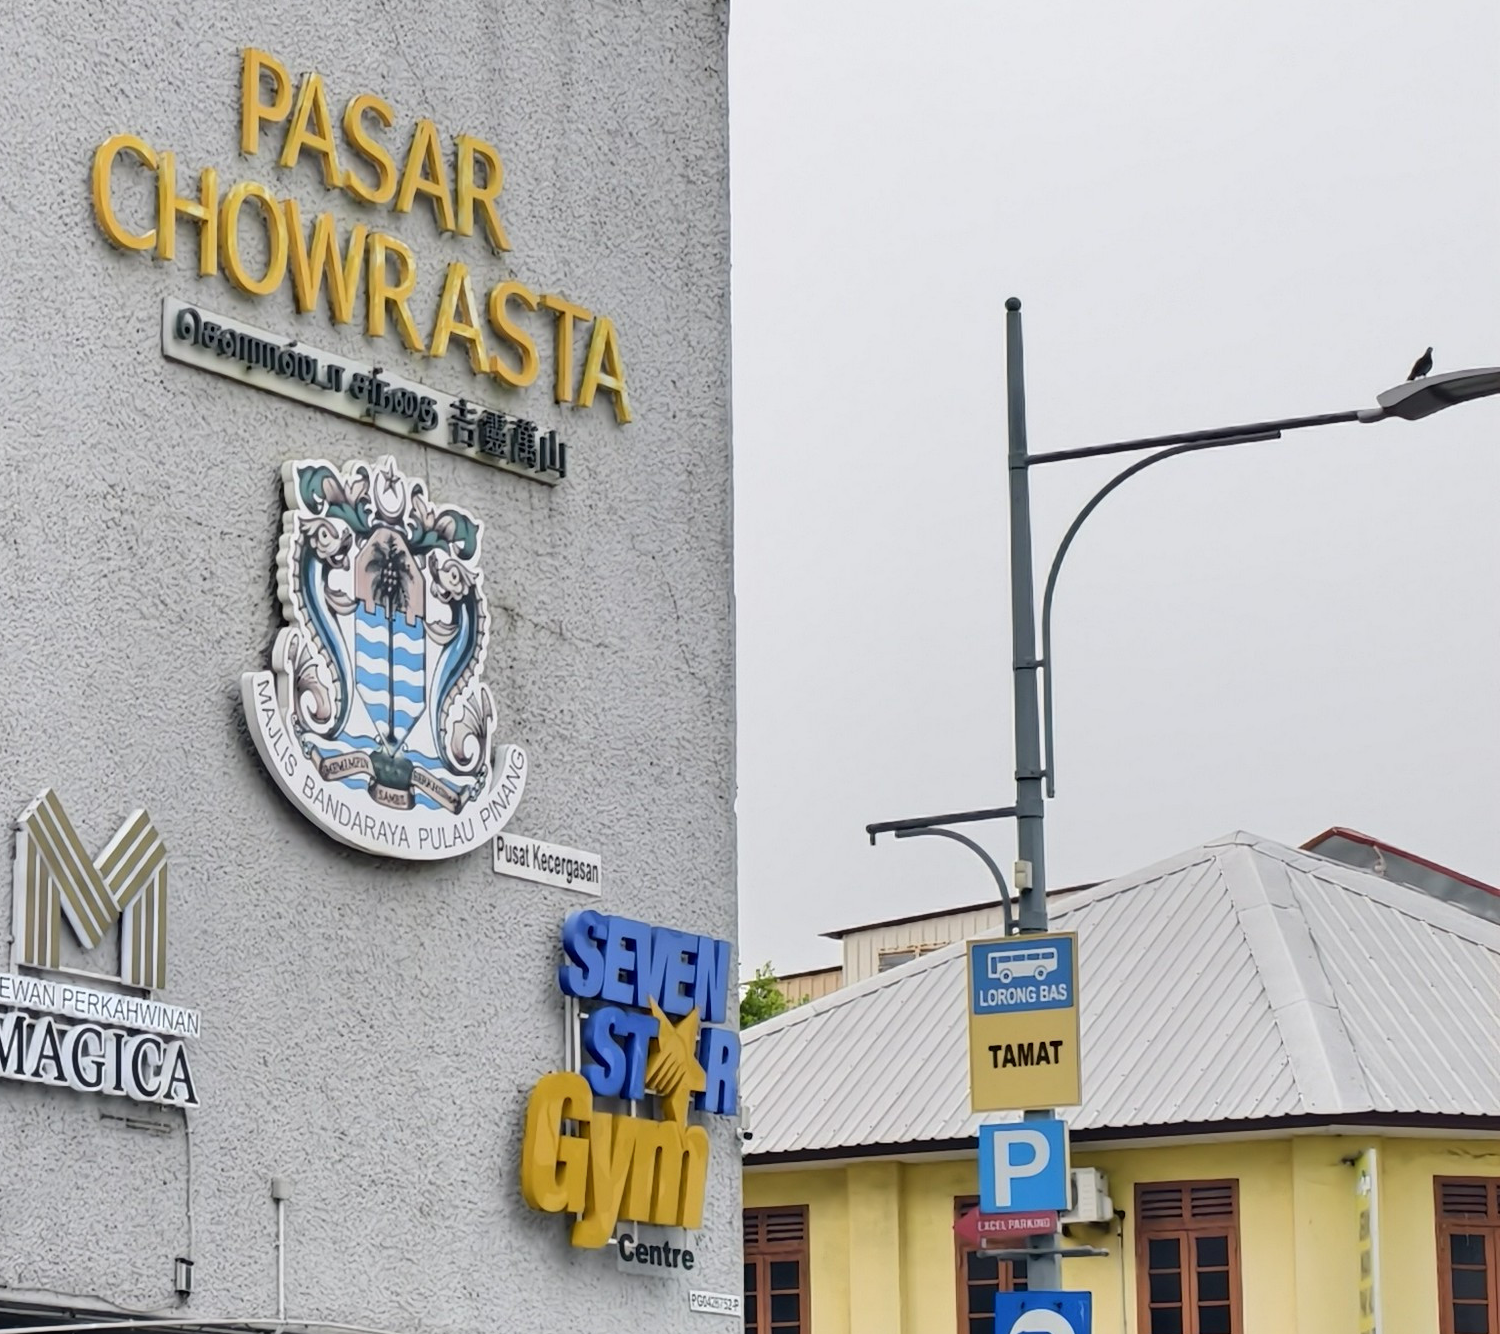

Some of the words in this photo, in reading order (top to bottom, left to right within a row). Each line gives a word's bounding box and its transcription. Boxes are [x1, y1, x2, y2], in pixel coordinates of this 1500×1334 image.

[239, 46, 513, 253] PASAR
[90, 133, 633, 425] CHOWRASTA
[256, 678, 299, 777] MAJLIS
[302, 774, 412, 850] BANDARAYA
[417, 818, 476, 851] PULAU
[479, 747, 526, 834] PINANG
[496, 835, 530, 868] Pusat
[532, 843, 599, 884] Kecergasan
[560, 909, 731, 1023] SEVEN
[979, 986, 1037, 1007] LORONG
[1040, 984, 1068, 1003] BAS
[62, 988, 199, 1035] PERKAHWINAN
[988, 1041, 1063, 1069] TAMAT
[521, 1072, 709, 1248] Gym
[994, 1130, 1051, 1207] P
[619, 1233, 694, 1270] Centre
